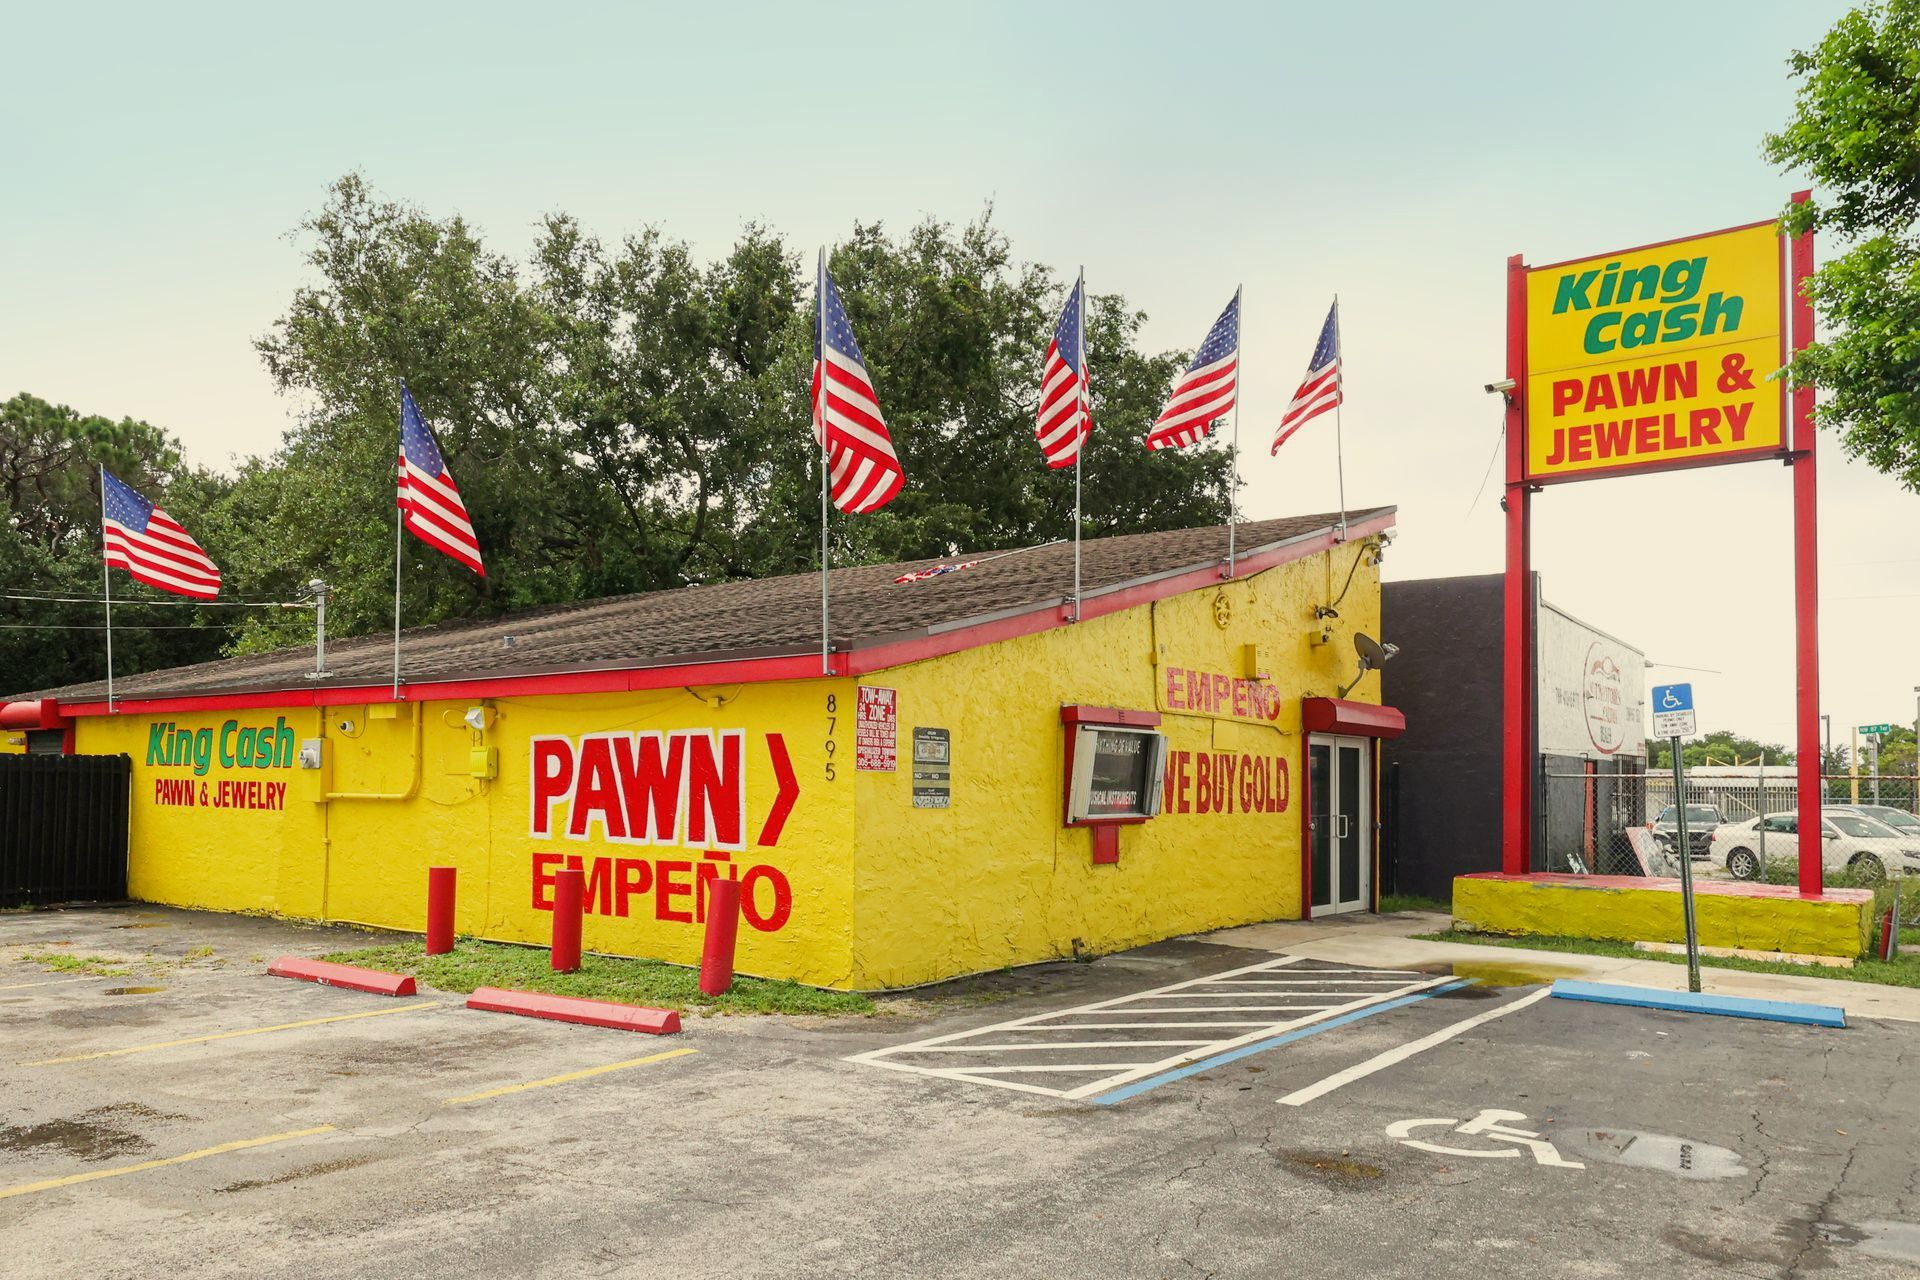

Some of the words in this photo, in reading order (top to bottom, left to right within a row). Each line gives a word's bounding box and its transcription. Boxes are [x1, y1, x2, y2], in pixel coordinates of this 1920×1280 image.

[1552, 255, 1709, 315] King
[1583, 290, 1744, 355] Cash
[1552, 360, 1698, 418] PAWN
[1716, 352, 1757, 394] &
[1546, 402, 1755, 466] JEWELRY
[825, 694, 837, 781] 8795
[857, 711, 867, 721] HRS
[858, 702, 866, 712] 24
[869, 704, 886, 722] ZONE
[145, 721, 214, 776] King
[218, 716, 295, 769] Cash
[155, 778, 195, 807] PAWN
[199, 781, 209, 808] &
[213, 780, 287, 811] JEWELRY
[532, 734, 742, 846] PAWN
[1196, 752, 1238, 814] BUY
[1240, 753, 1290, 813] GOLD
[531, 850, 793, 933] EMPEÑO
